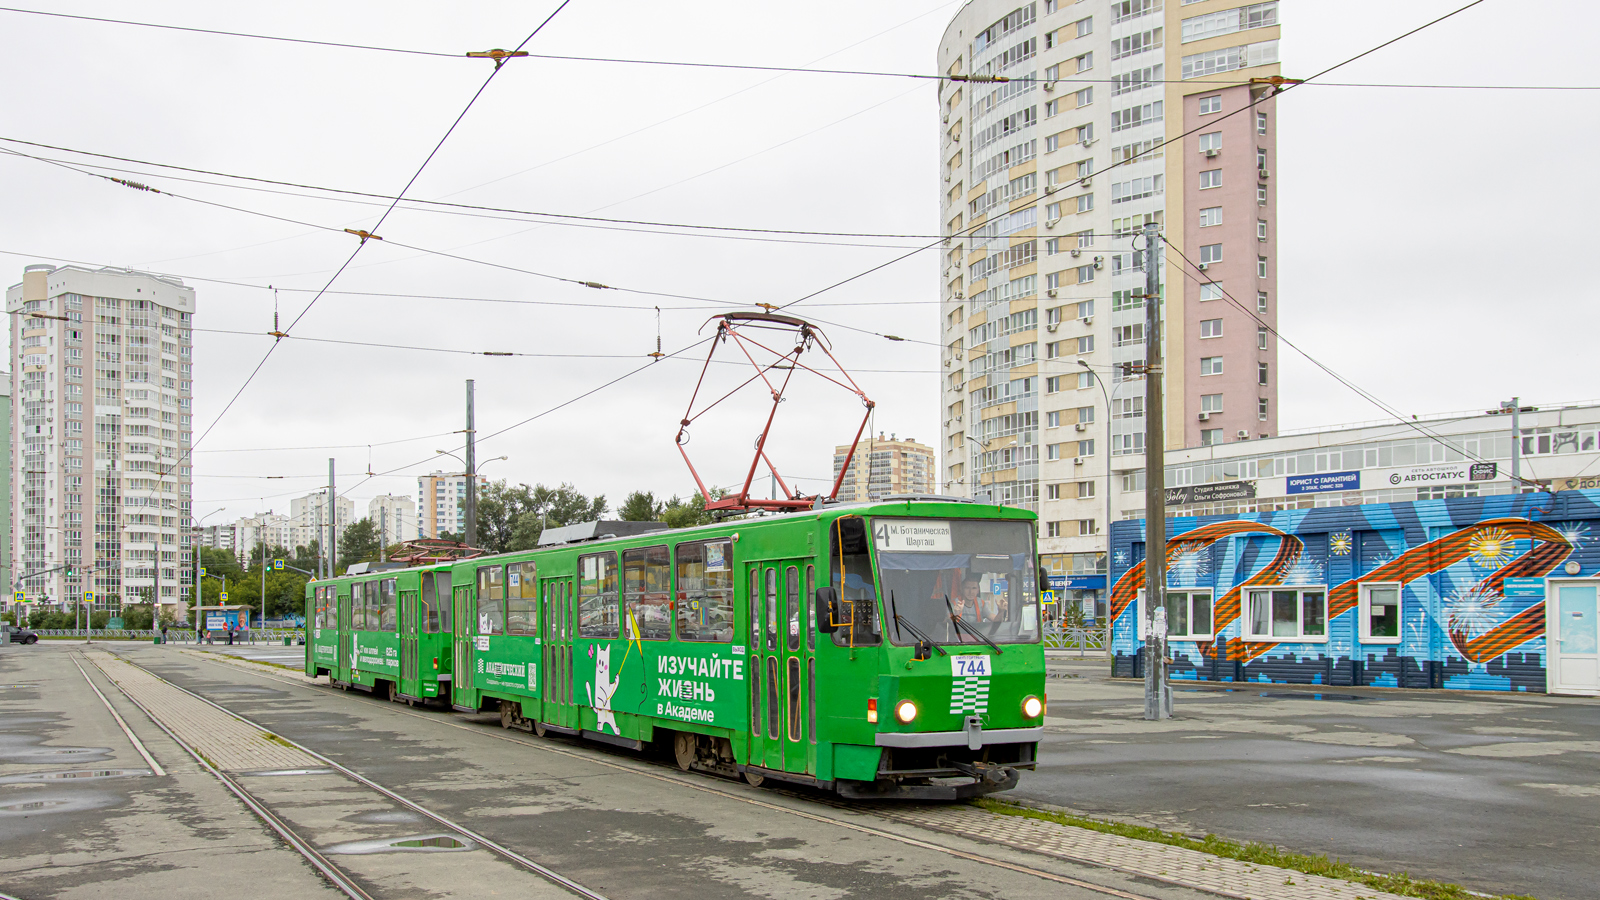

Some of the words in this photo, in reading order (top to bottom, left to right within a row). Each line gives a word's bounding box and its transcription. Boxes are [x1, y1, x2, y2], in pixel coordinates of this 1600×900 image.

[1290, 478, 1312, 486] ЮРИСТ
[1320, 474, 1357, 484] ГАРАНТИЕЙ
[1404, 470, 1465, 482] АВТОСТАТУС
[1194, 485, 1214, 494] Студия
[1215, 483, 1240, 491] макияжа
[1194, 493, 1211, 501] Ольги
[1212, 490, 1248, 500] Софроновой
[876, 523, 890, 548] 4
[900, 525, 950, 536] Ботаническая
[906, 537, 935, 548] Шарташ
[510, 574, 519, 586] 744
[658, 653, 744, 680] ИЗУЧАЙТЕ
[957, 660, 986, 675] 744
[658, 678, 715, 702] ЖИЗНЬ
[657, 703, 663, 715] в
[665, 701, 715, 722] Академе
